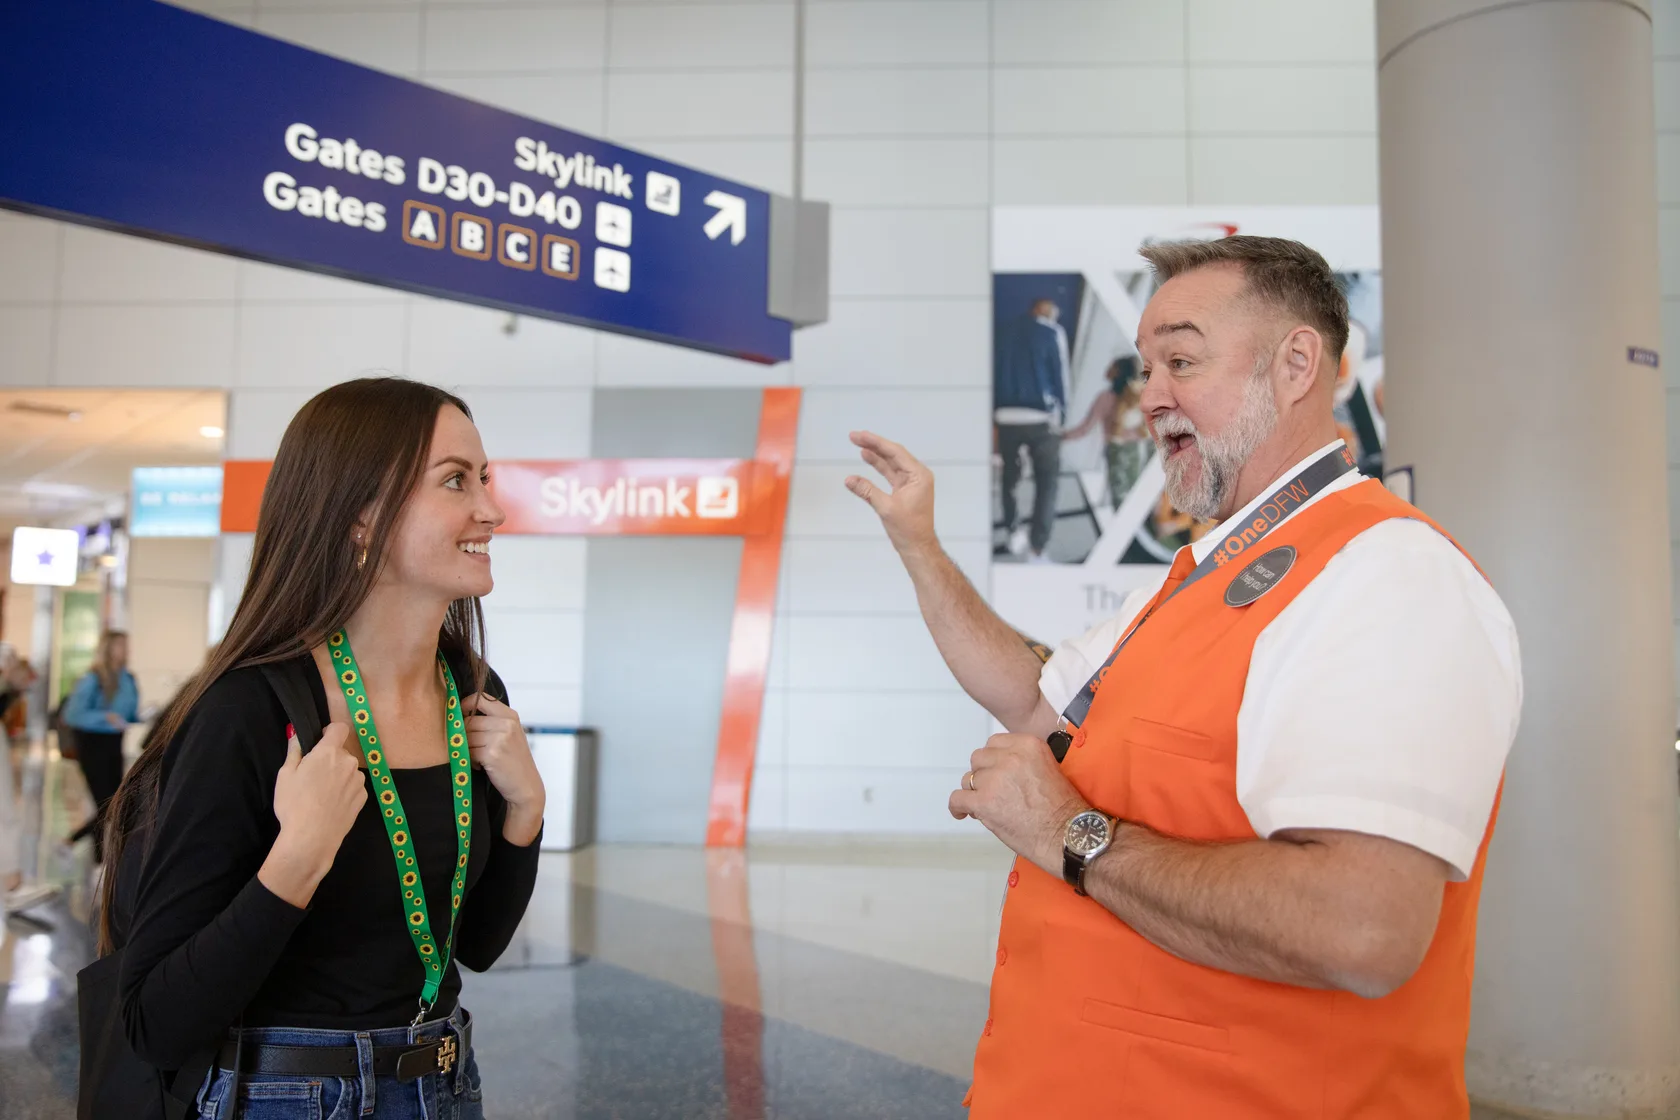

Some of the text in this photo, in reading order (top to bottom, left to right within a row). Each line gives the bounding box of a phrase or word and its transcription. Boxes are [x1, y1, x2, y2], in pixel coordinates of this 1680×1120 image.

[284, 122, 582, 230] Gates D30-D40
[514, 136, 634, 200] Skylink
[263, 171, 571, 272] Gates A B C E
[540, 477, 691, 525] Skylink
[1213, 479, 1309, 567] #OneDFW
